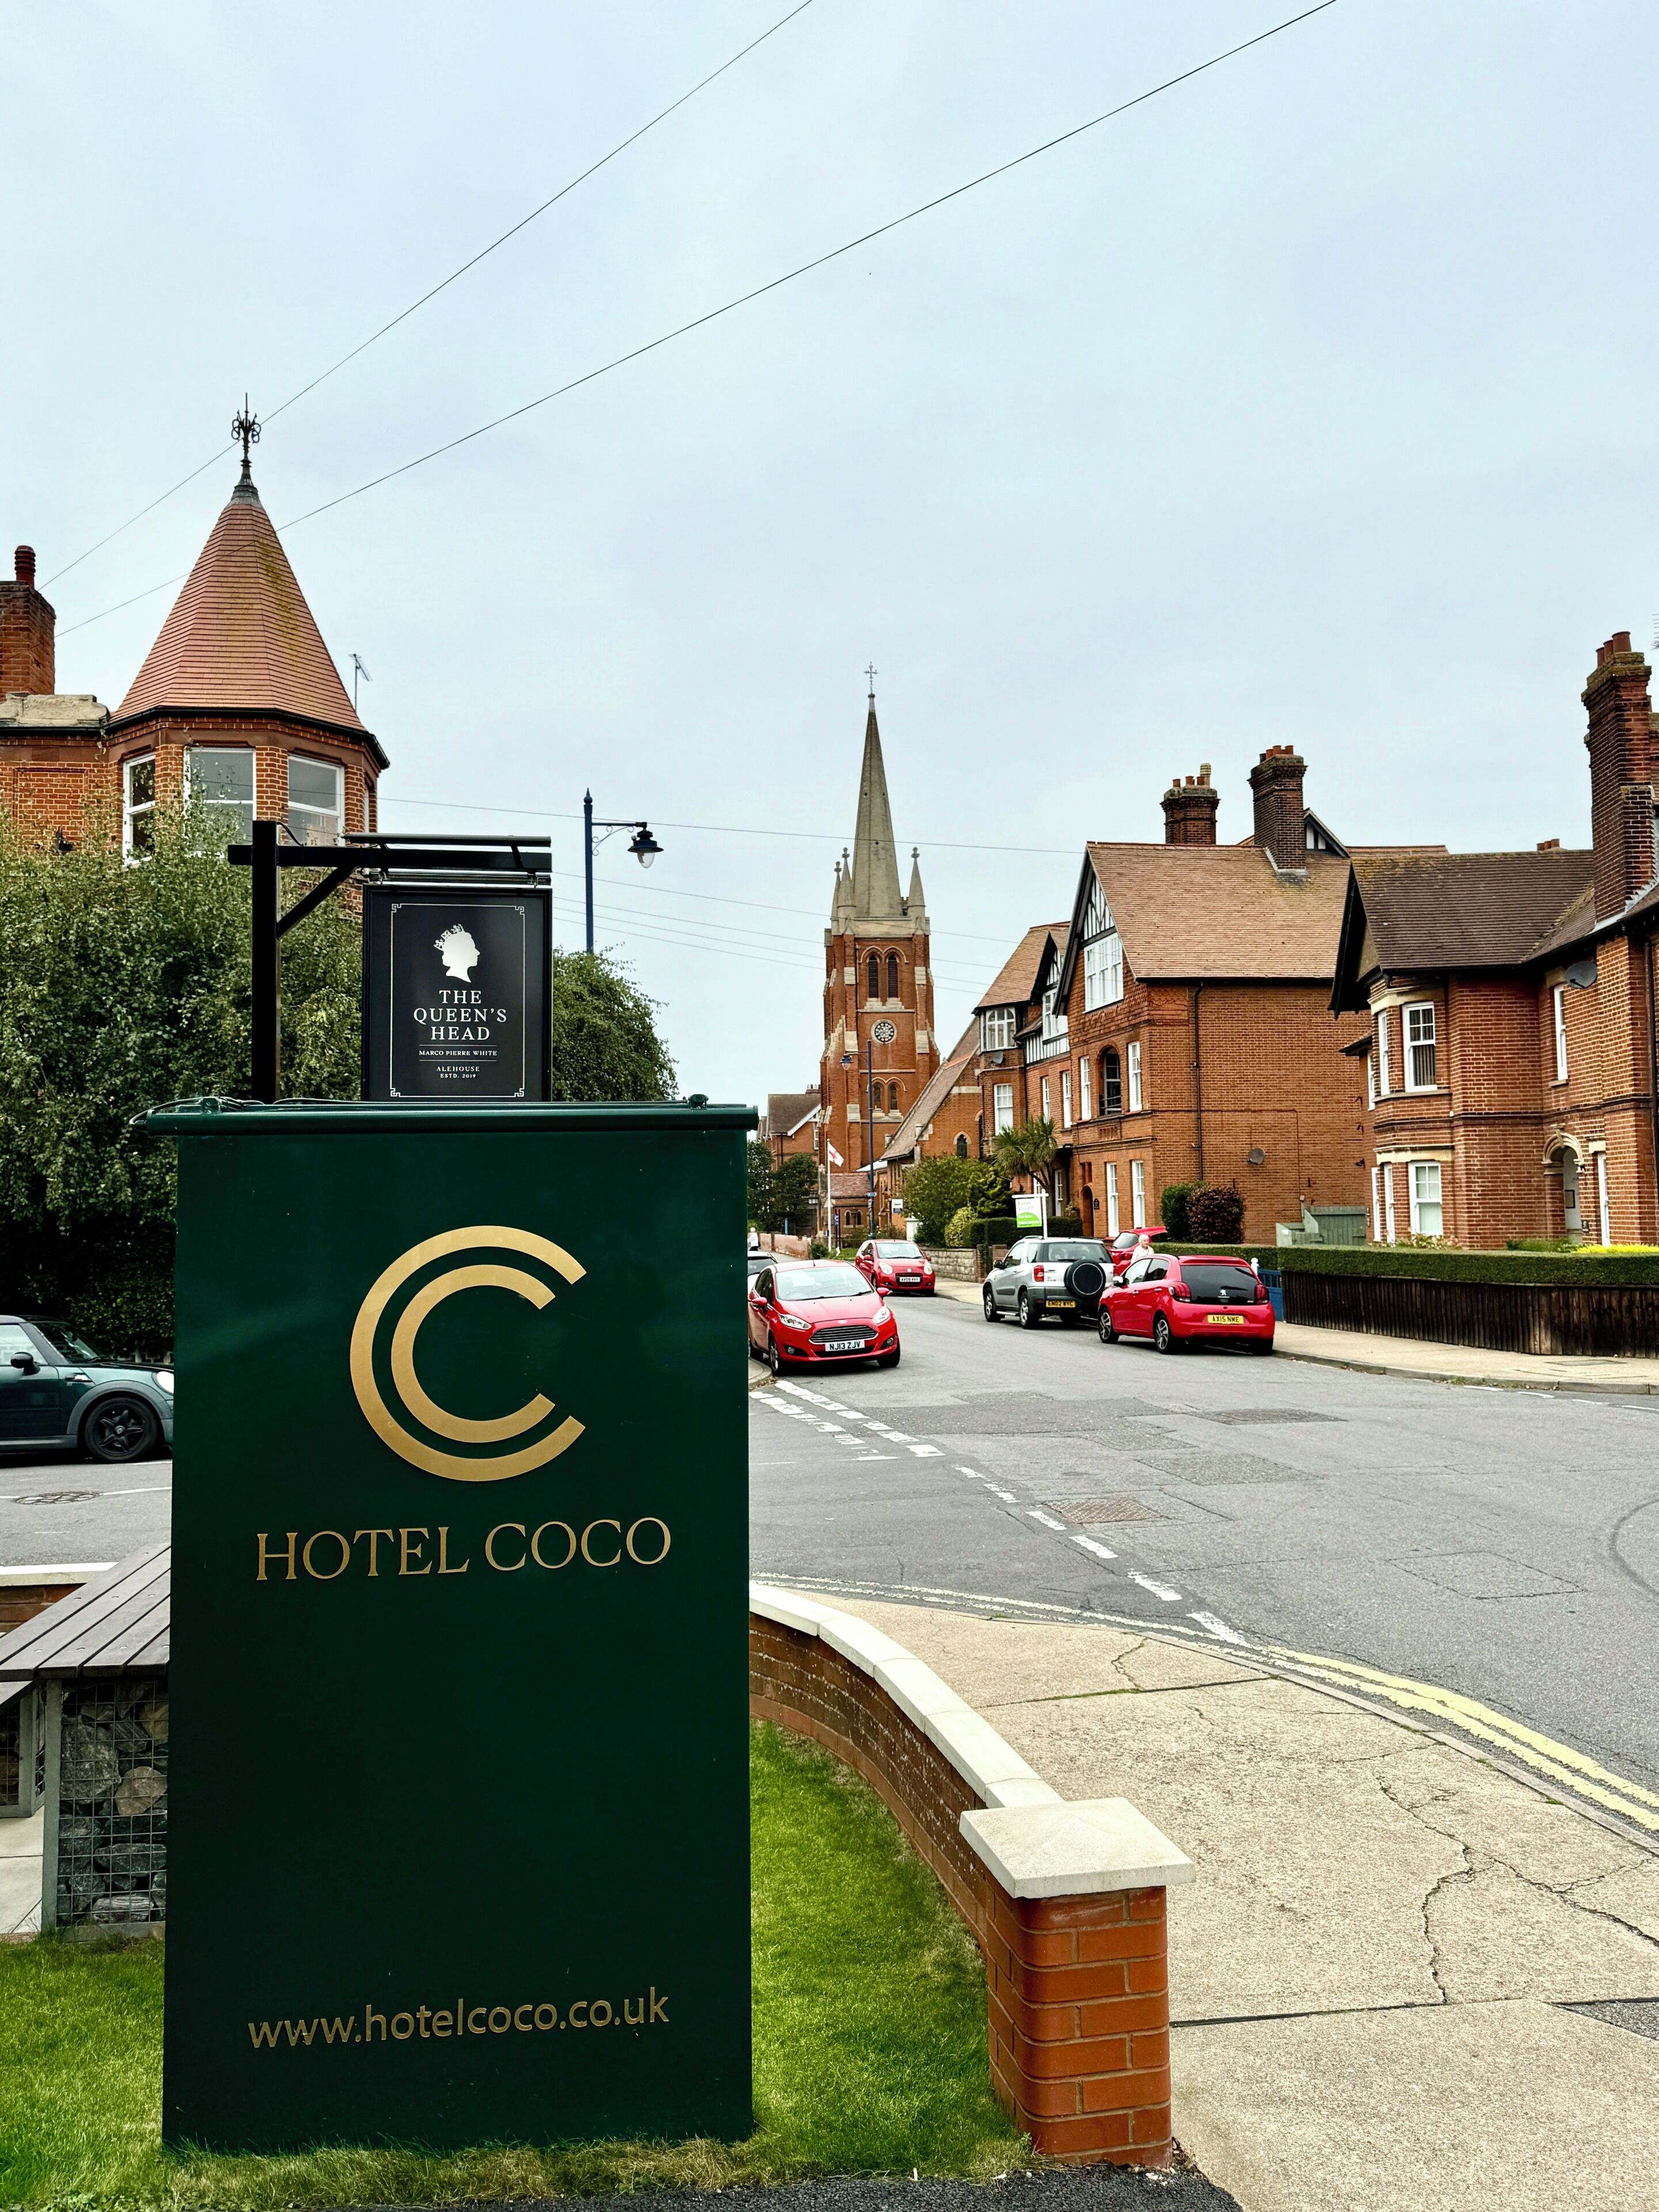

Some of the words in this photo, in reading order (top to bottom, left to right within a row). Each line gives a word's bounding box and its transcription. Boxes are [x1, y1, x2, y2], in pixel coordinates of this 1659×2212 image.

[439, 990, 482, 1004] THE
[413, 1007, 507, 1025] QUEEN'S
[430, 1026, 490, 1040] HEAD
[847, 1341, 861, 1349] ZJV
[257, 1527, 469, 1580] HOTEL
[485, 1517, 671, 1571] COCO
[248, 1987, 669, 2048] www.hotelcoco.co.uk
